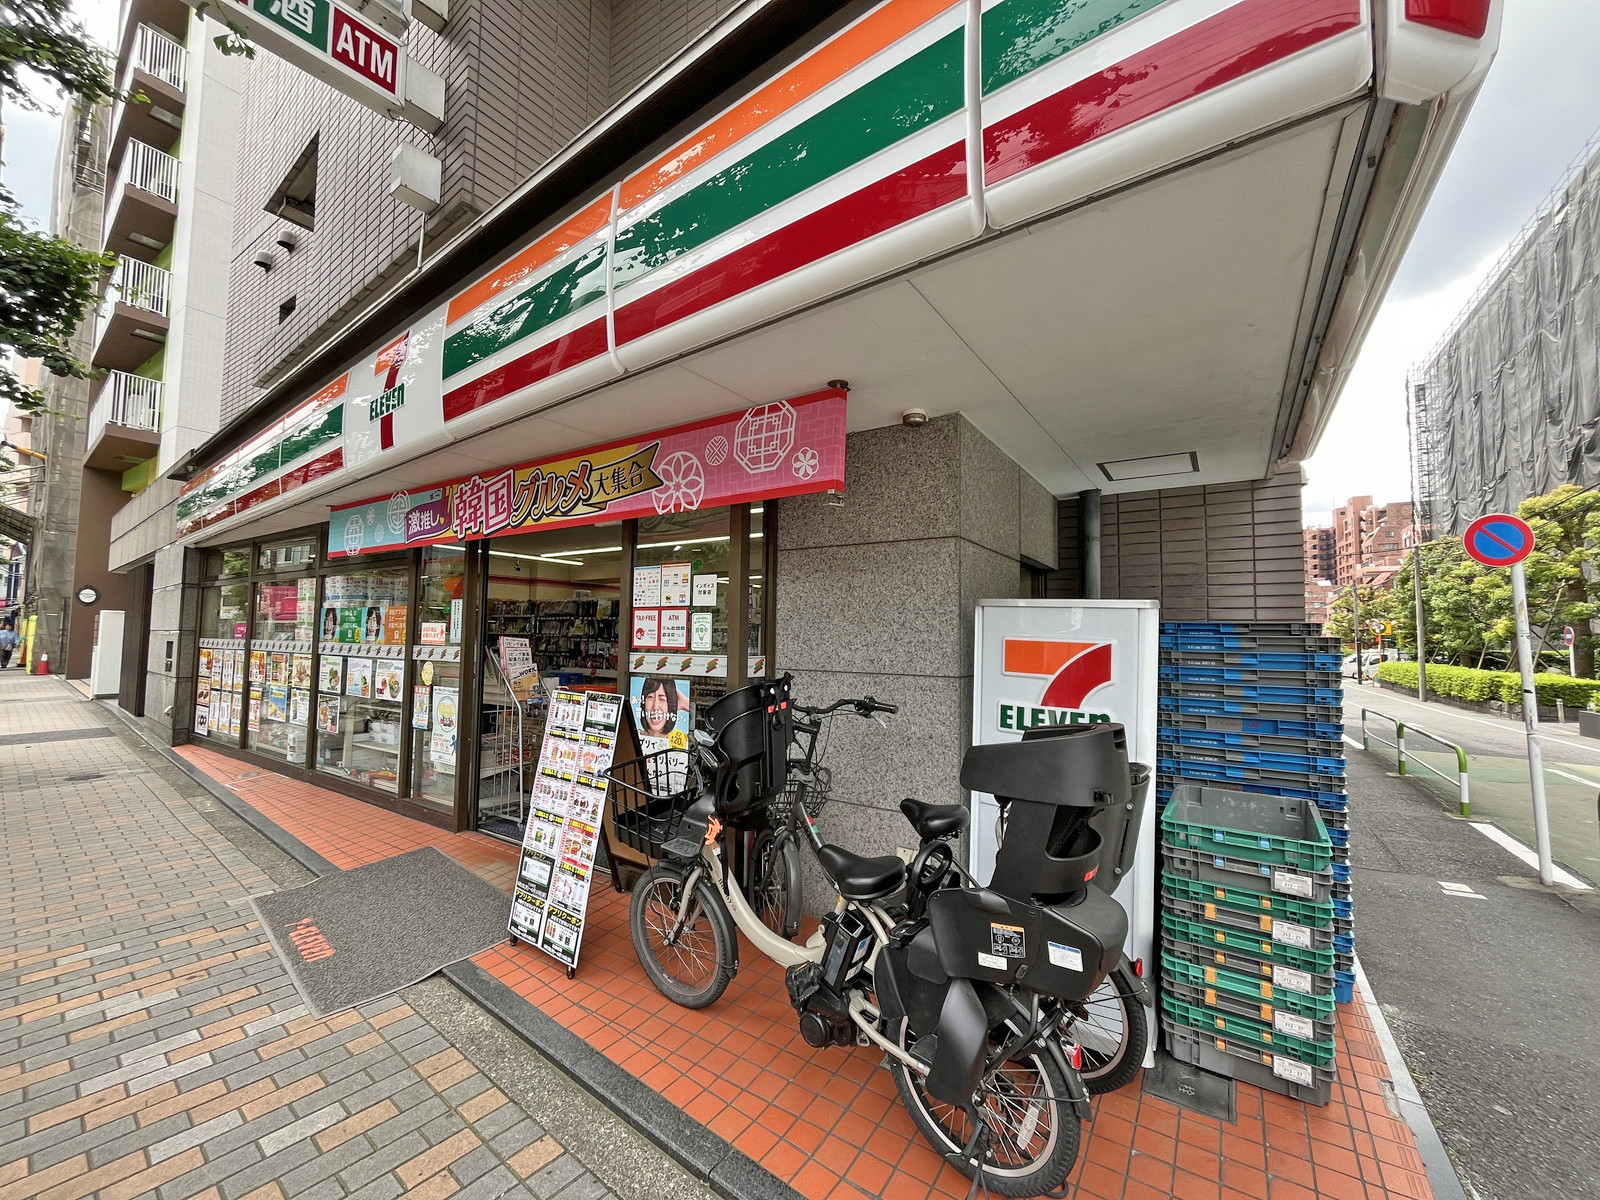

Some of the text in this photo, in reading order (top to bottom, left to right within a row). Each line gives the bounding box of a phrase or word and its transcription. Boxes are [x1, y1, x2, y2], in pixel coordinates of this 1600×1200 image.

[269, 0, 316, 34] 酒
[336, 22, 394, 84] ATM
[408, 460, 645, 538] 激推し 韓国グルメ 大集合
[1005, 639, 1112, 710] 7
[515, 890, 546, 908] アプリクーポン
[548, 906, 582, 926] アプリクーポン
[557, 933, 571, 947] 半額
